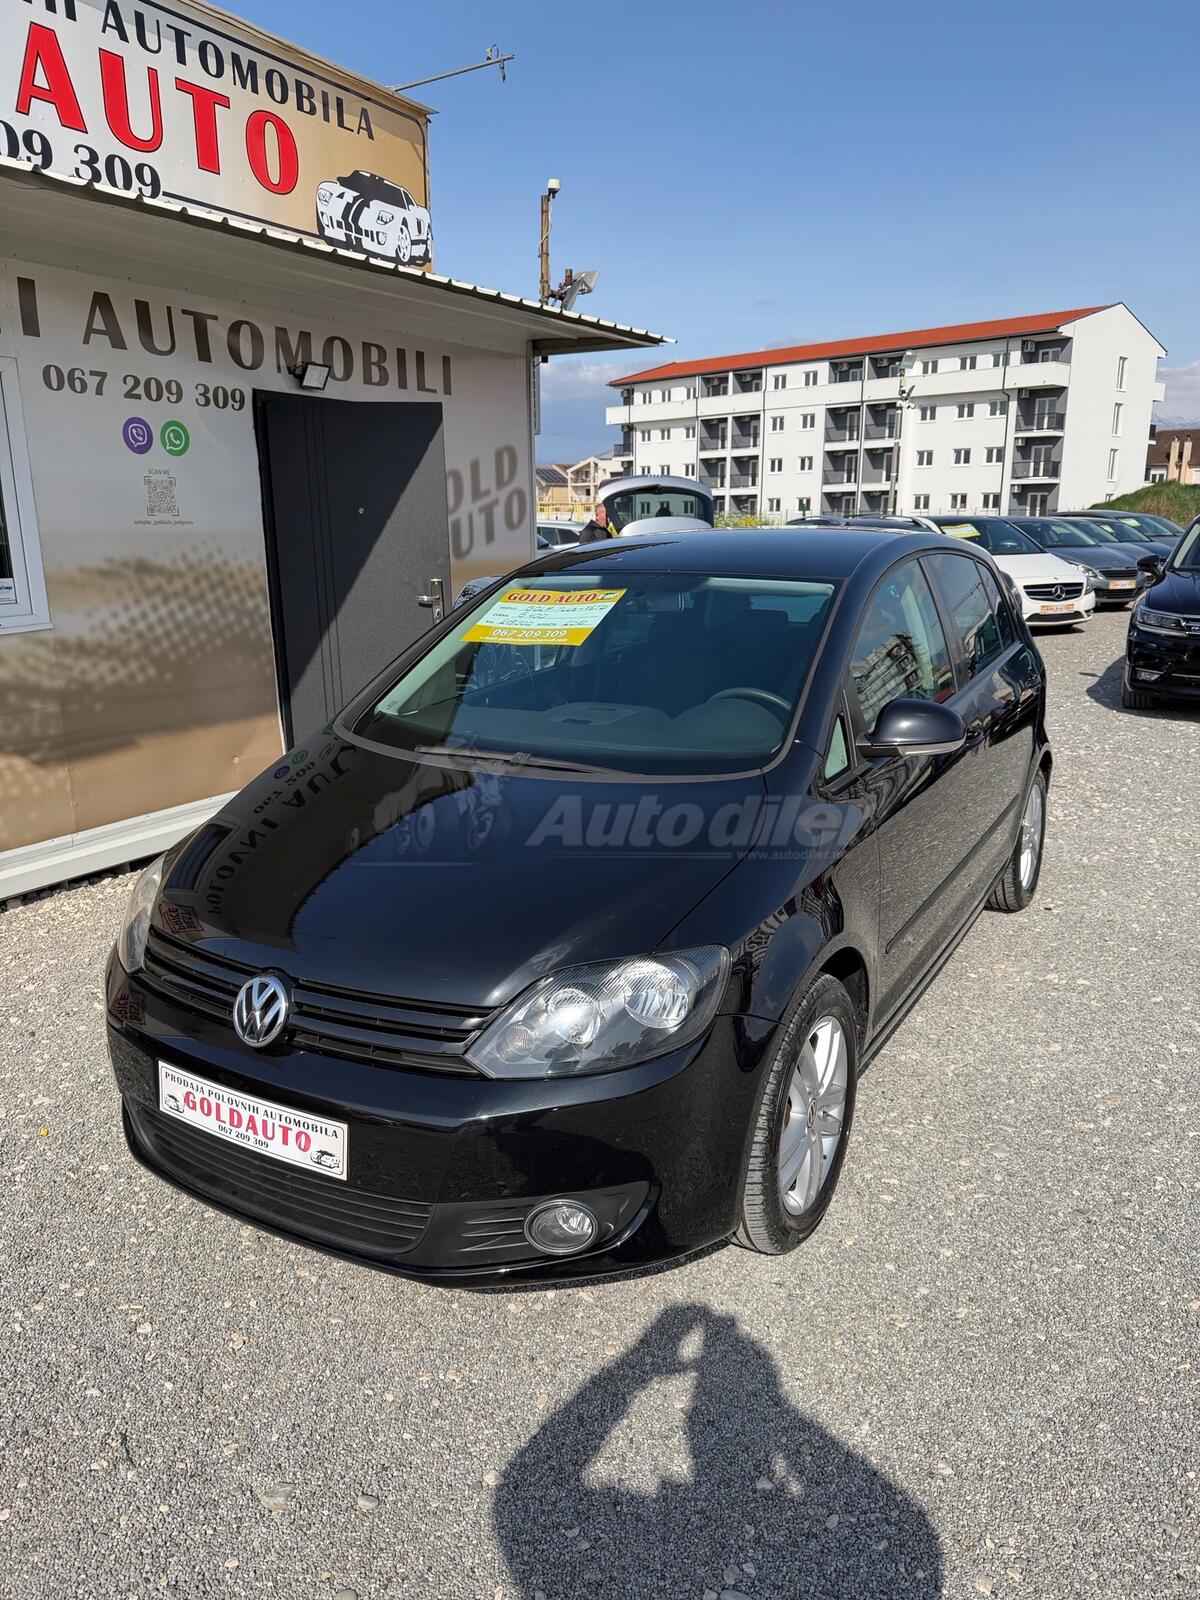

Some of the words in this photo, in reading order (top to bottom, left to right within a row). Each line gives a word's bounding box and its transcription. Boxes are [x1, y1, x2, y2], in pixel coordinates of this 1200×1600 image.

[101, 0, 375, 141] AUTOMOBILA
[15, 21, 299, 195] AUTO
[0, 120, 53, 170] 09
[73, 143, 161, 199] 309
[82, 290, 453, 396] AUTOMOBILI
[42, 364, 108, 396] 067
[122, 374, 184, 404] 209
[195, 383, 246, 411] 309
[446, 444, 518, 516] OLD
[451, 487, 528, 561] UTO
[507, 592, 552, 603] GOLD
[555, 592, 598, 603] AUTO
[492, 628, 517, 637] 067
[517, 629, 541, 638] 209
[543, 629, 568, 637] 309
[165, 1071, 205, 1095] PRODAJA
[208, 1089, 259, 1115] POLOVNIH
[263, 1109, 338, 1139] AUTOMOBILA
[184, 1090, 312, 1153] GOLDAUTO
[218, 1124, 233, 1136] 067
[235, 1130, 251, 1142] 209
[252, 1136, 269, 1149] 309
